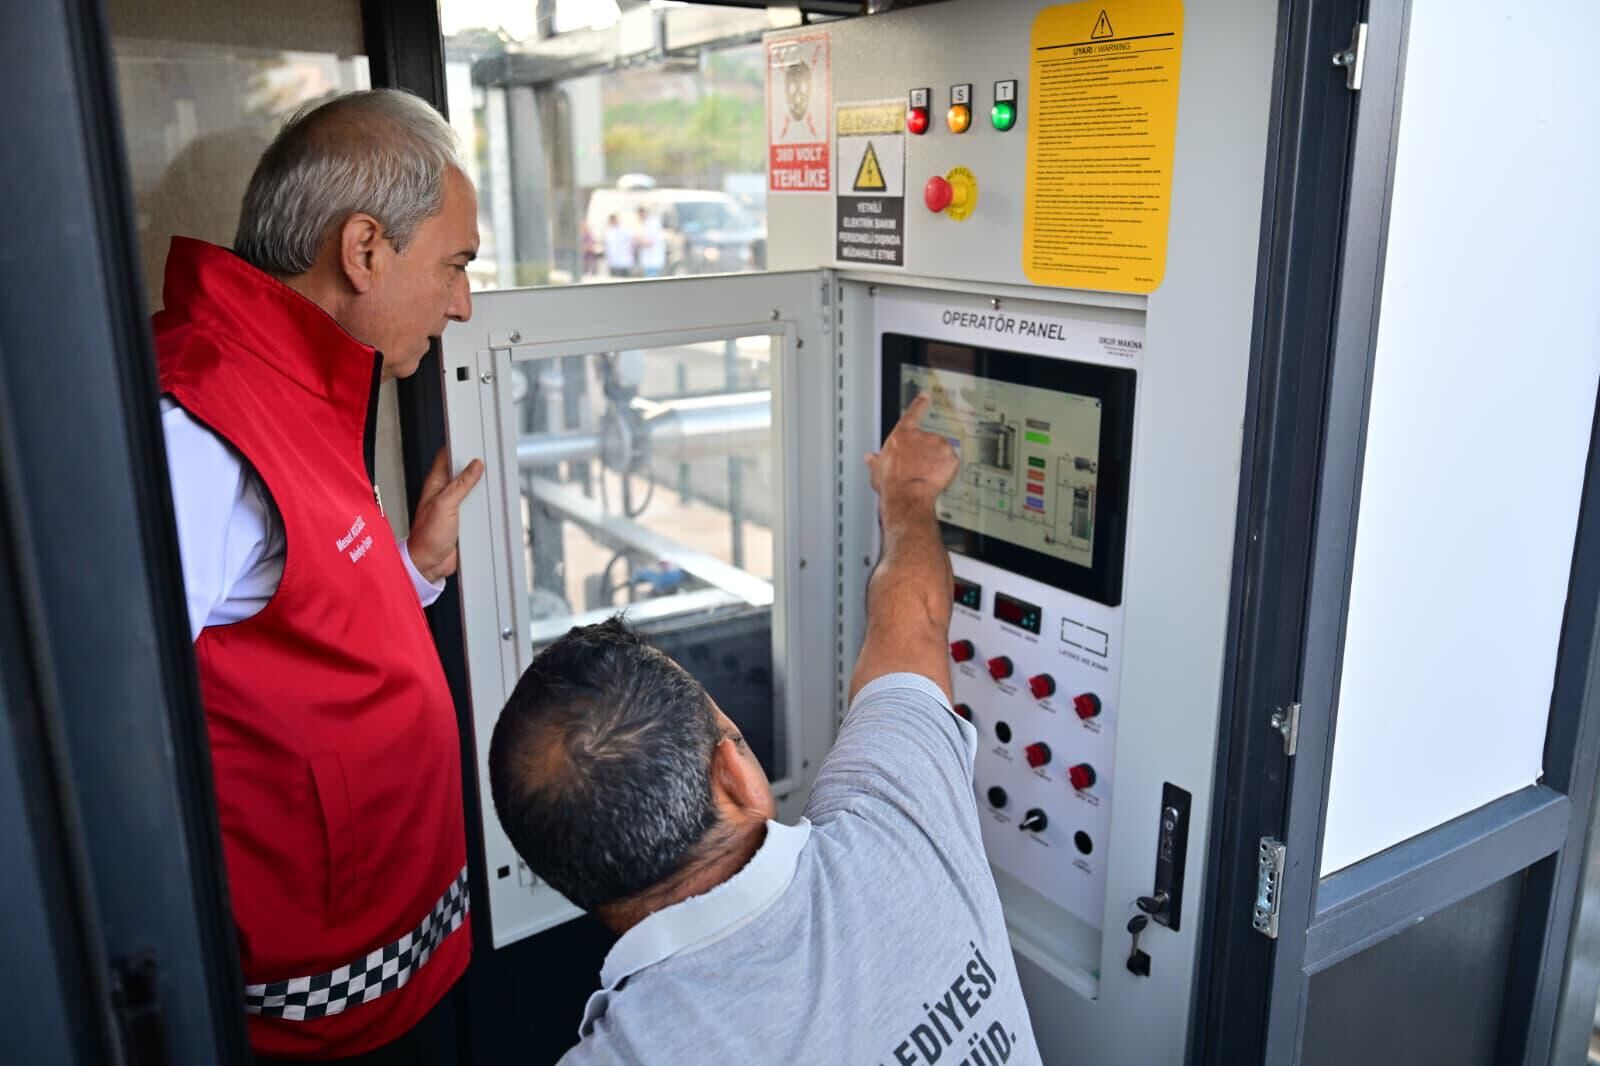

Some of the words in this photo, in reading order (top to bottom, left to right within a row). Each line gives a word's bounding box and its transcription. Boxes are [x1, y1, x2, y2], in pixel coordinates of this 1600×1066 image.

[1073, 46, 1094, 56] UYARI
[1098, 42, 1131, 53] WARNING
[957, 89, 965, 100] S
[1001, 86, 1008, 98] T
[797, 147, 822, 161] VOLT
[772, 165, 827, 188] TEHLİKE
[942, 309, 1015, 334] OPERATÖR
[1018, 320, 1067, 342] PANEL
